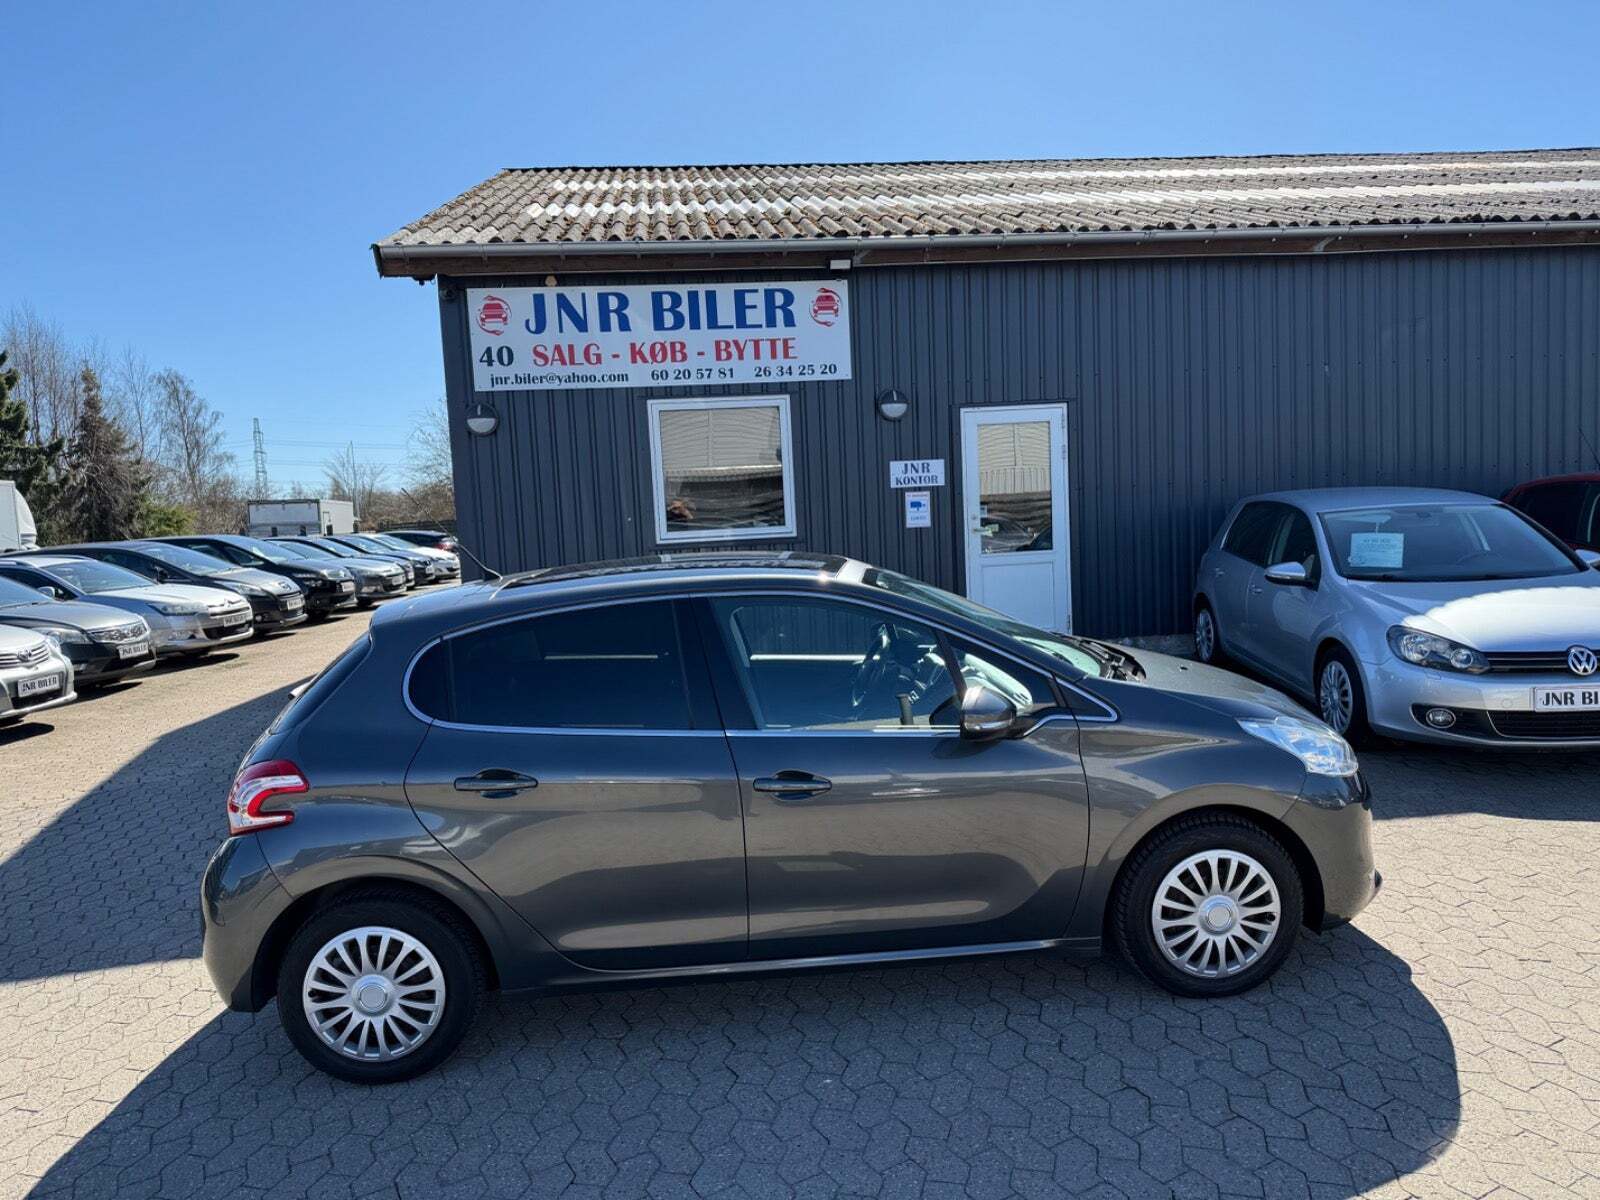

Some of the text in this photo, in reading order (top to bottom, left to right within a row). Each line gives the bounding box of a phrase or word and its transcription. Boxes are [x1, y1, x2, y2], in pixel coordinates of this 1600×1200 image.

[525, 288, 796, 334] JNR BILER
[479, 345, 514, 367] 40
[532, 343, 602, 367] SALG
[630, 340, 688, 365] KØB
[714, 337, 798, 361] BYTTE
[651, 367, 734, 381] 60 20 57 81
[754, 363, 838, 377] 26 34 25 20
[490, 372, 629, 388] jnr.biler@yahoo.com
[902, 462, 931, 474] JNR
[895, 475, 938, 486] KONTOR
[1543, 691, 1575, 706] JNR
